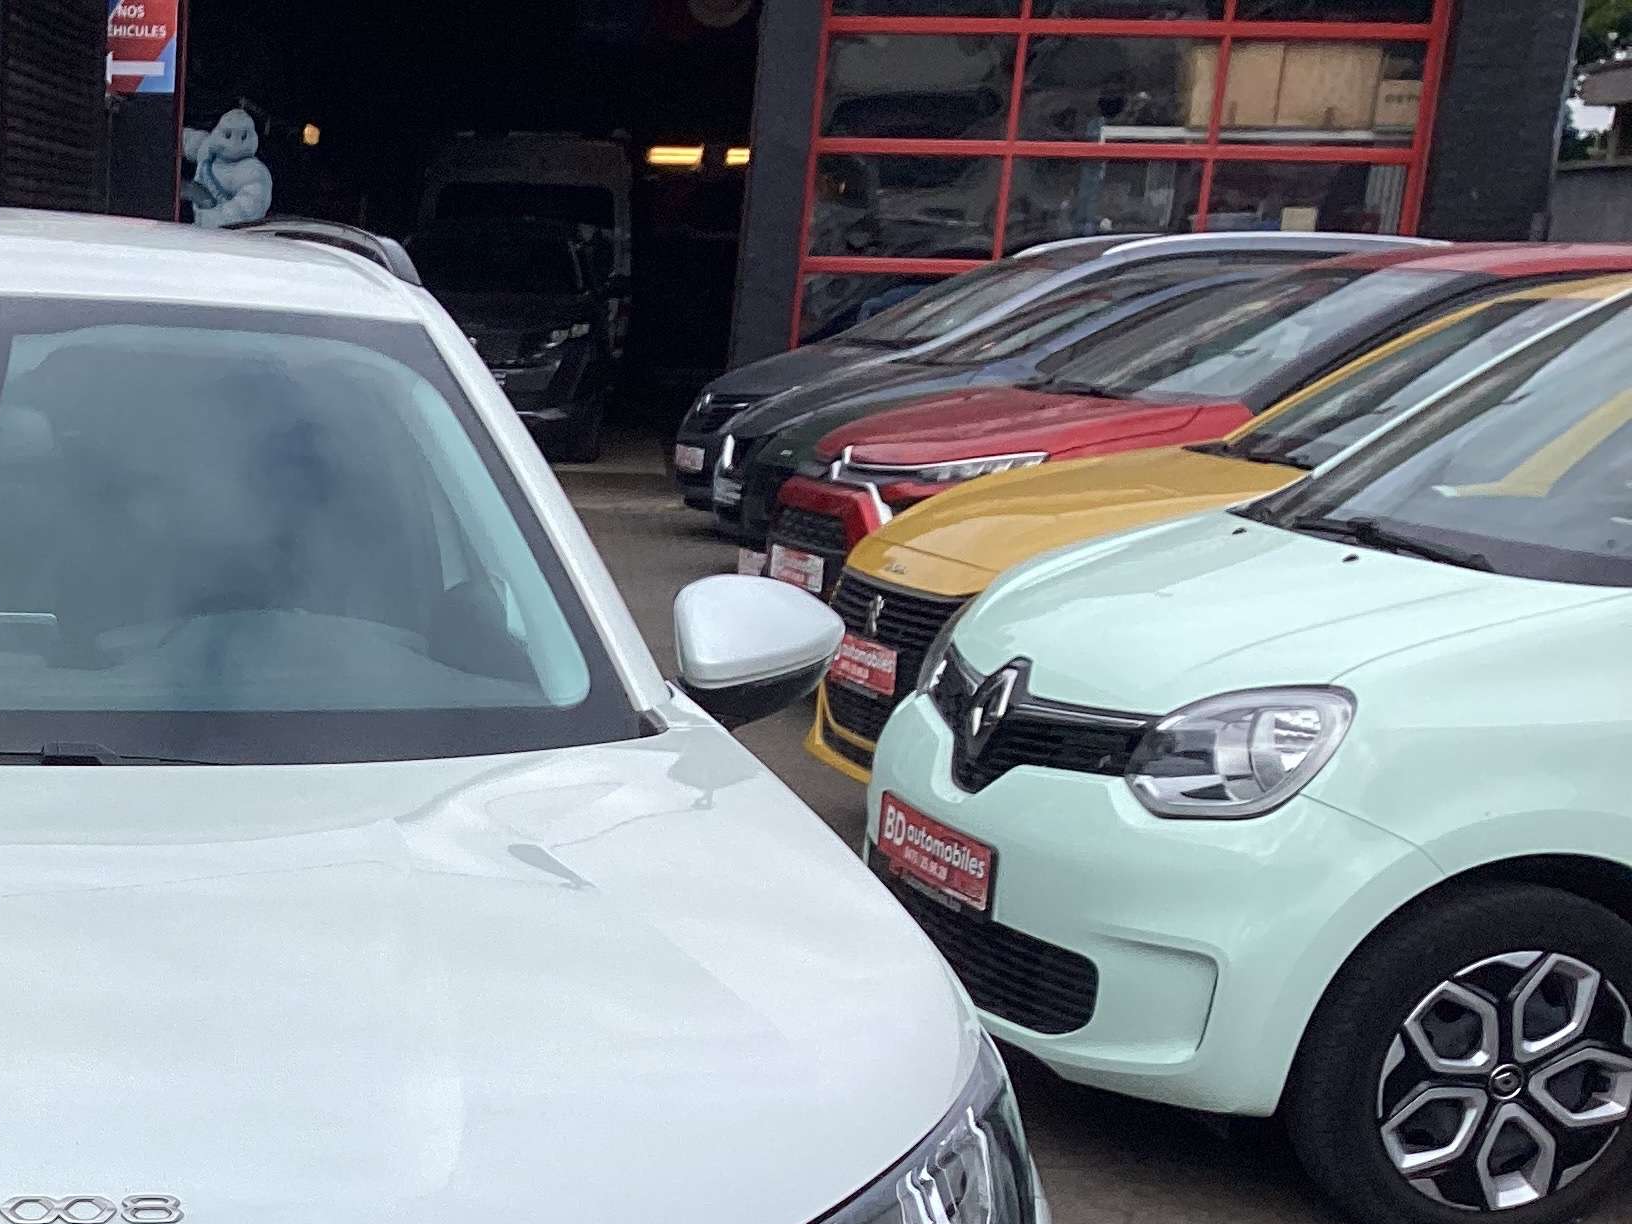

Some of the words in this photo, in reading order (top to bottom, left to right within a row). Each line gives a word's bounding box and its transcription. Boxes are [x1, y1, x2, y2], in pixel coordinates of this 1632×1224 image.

[117, 4, 145, 18] NOS
[884, 804, 906, 846] BD
[907, 823, 986, 879] automobiles
